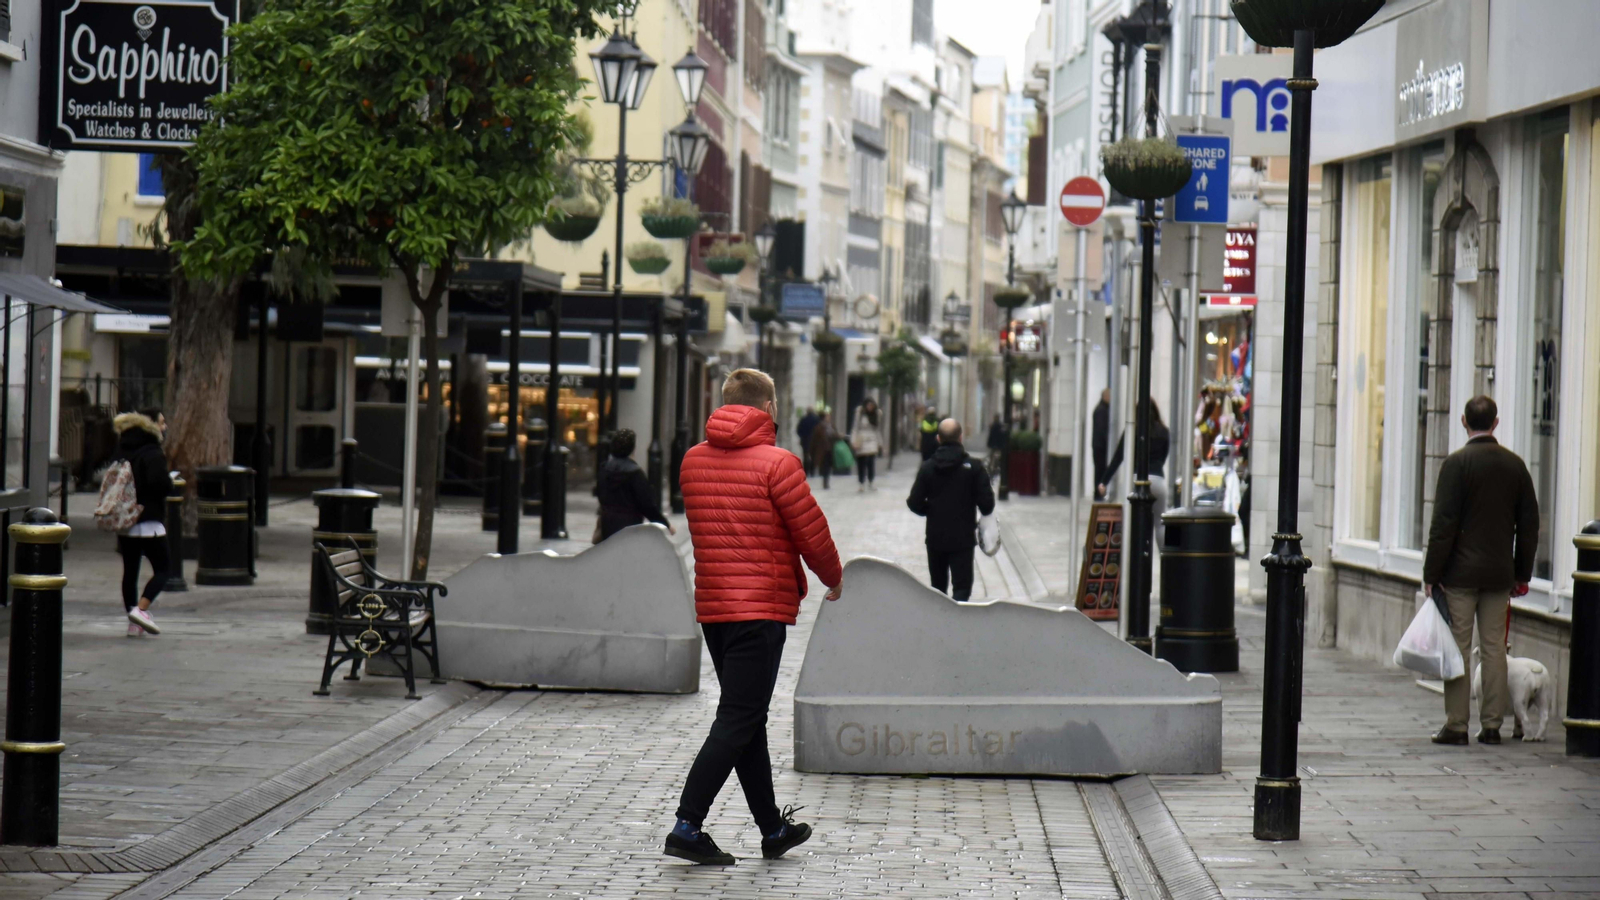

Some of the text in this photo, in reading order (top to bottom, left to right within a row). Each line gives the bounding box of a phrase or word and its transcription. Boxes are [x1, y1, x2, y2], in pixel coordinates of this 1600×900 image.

[1399, 59, 1464, 127] mothercare
[68, 98, 135, 119] Specialists
[140, 103, 152, 118] in
[86, 120, 198, 141] Watches & Clocks
[1183, 147, 1226, 159] SHARED
[1191, 158, 1217, 169] ONE
[500, 372, 583, 387] COCOATE
[836, 721, 1022, 757] Gibraltar
